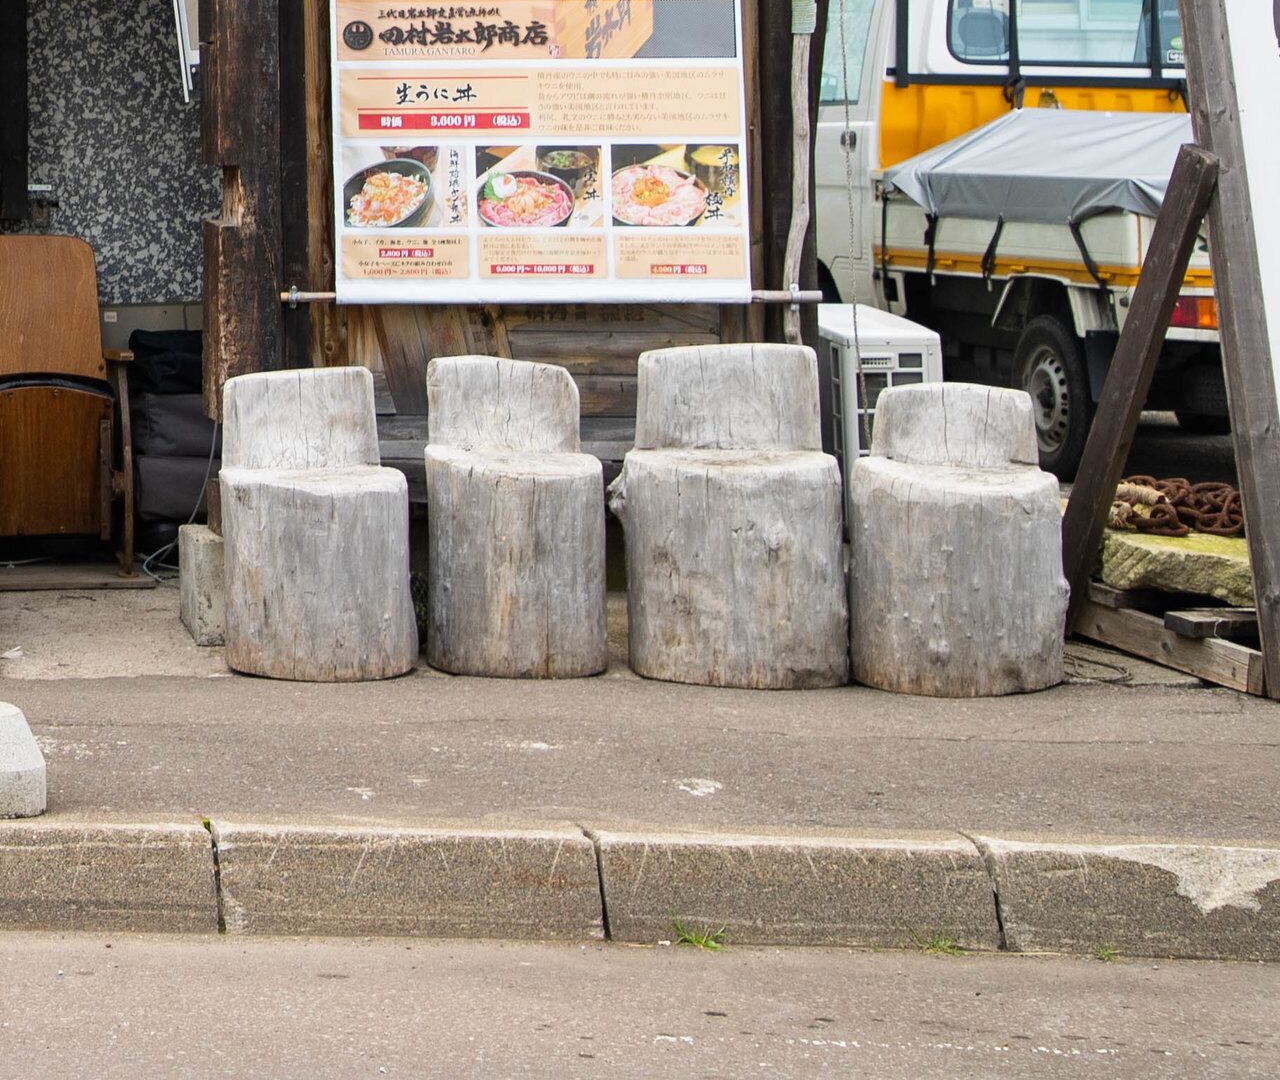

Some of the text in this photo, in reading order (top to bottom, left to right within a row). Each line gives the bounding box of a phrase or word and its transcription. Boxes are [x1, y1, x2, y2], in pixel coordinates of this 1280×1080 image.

[378, 21, 549, 52] 田村岩太郎商店
[384, 47, 476, 56] TAMURA GANTARO
[396, 82, 477, 104] 生うに丼
